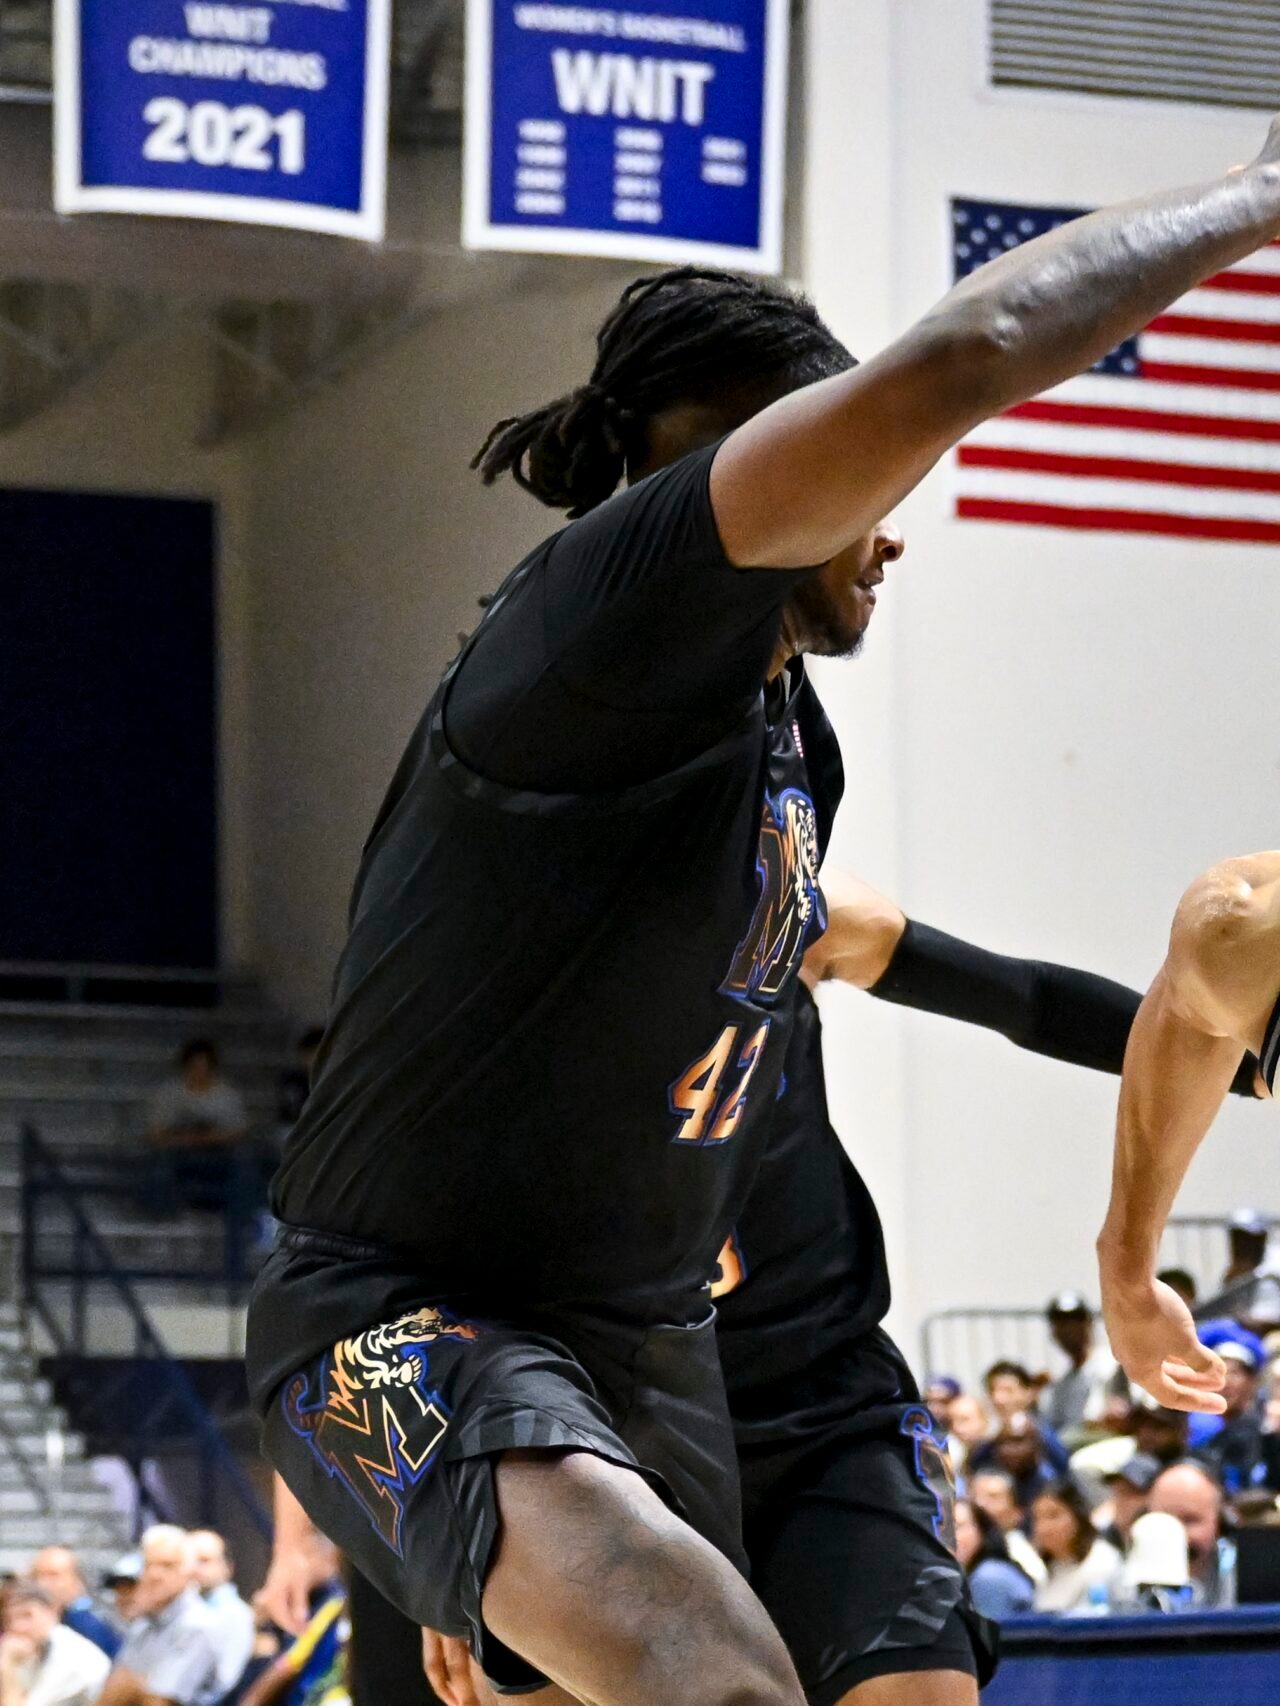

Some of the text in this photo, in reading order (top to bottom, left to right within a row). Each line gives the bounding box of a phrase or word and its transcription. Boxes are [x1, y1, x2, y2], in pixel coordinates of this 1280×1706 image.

[128, 34, 328, 91] CHAMPIONS
[183, 2, 274, 45] WNIT
[551, 47, 715, 127] WNIT
[142, 96, 306, 175] 2021
[668, 1018, 771, 1146] 42
